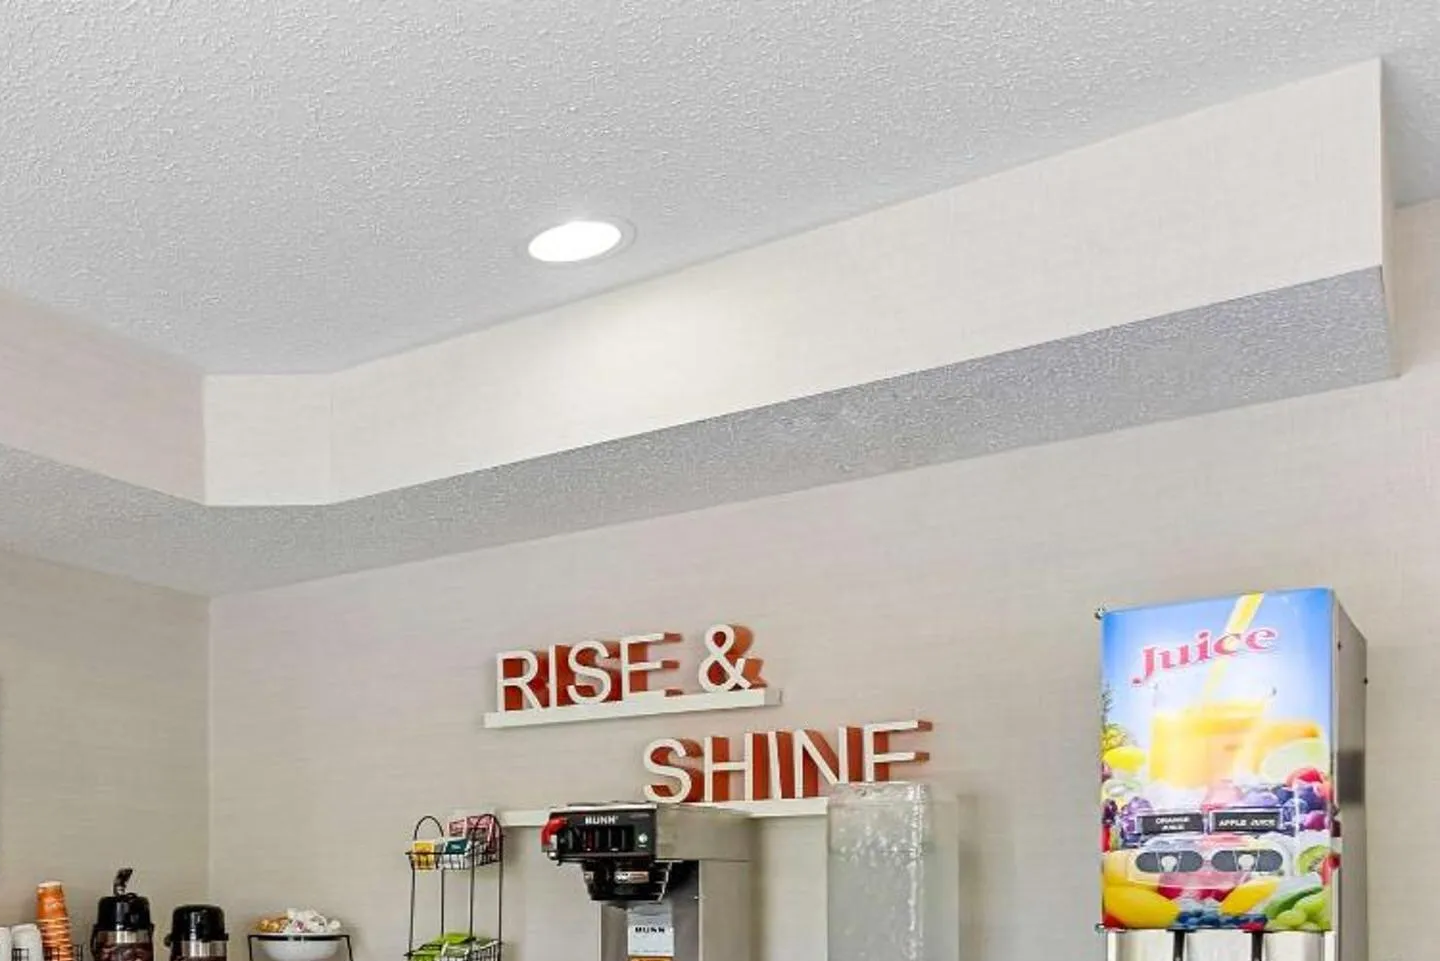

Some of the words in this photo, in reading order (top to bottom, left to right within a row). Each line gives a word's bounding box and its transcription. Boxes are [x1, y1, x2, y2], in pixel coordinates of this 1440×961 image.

[496, 632, 677, 712] RISE
[697, 623, 765, 693] &
[1130, 629, 1278, 686] Juice
[643, 720, 931, 803] SHINE
[1218, 819, 1246, 827] APPLE
